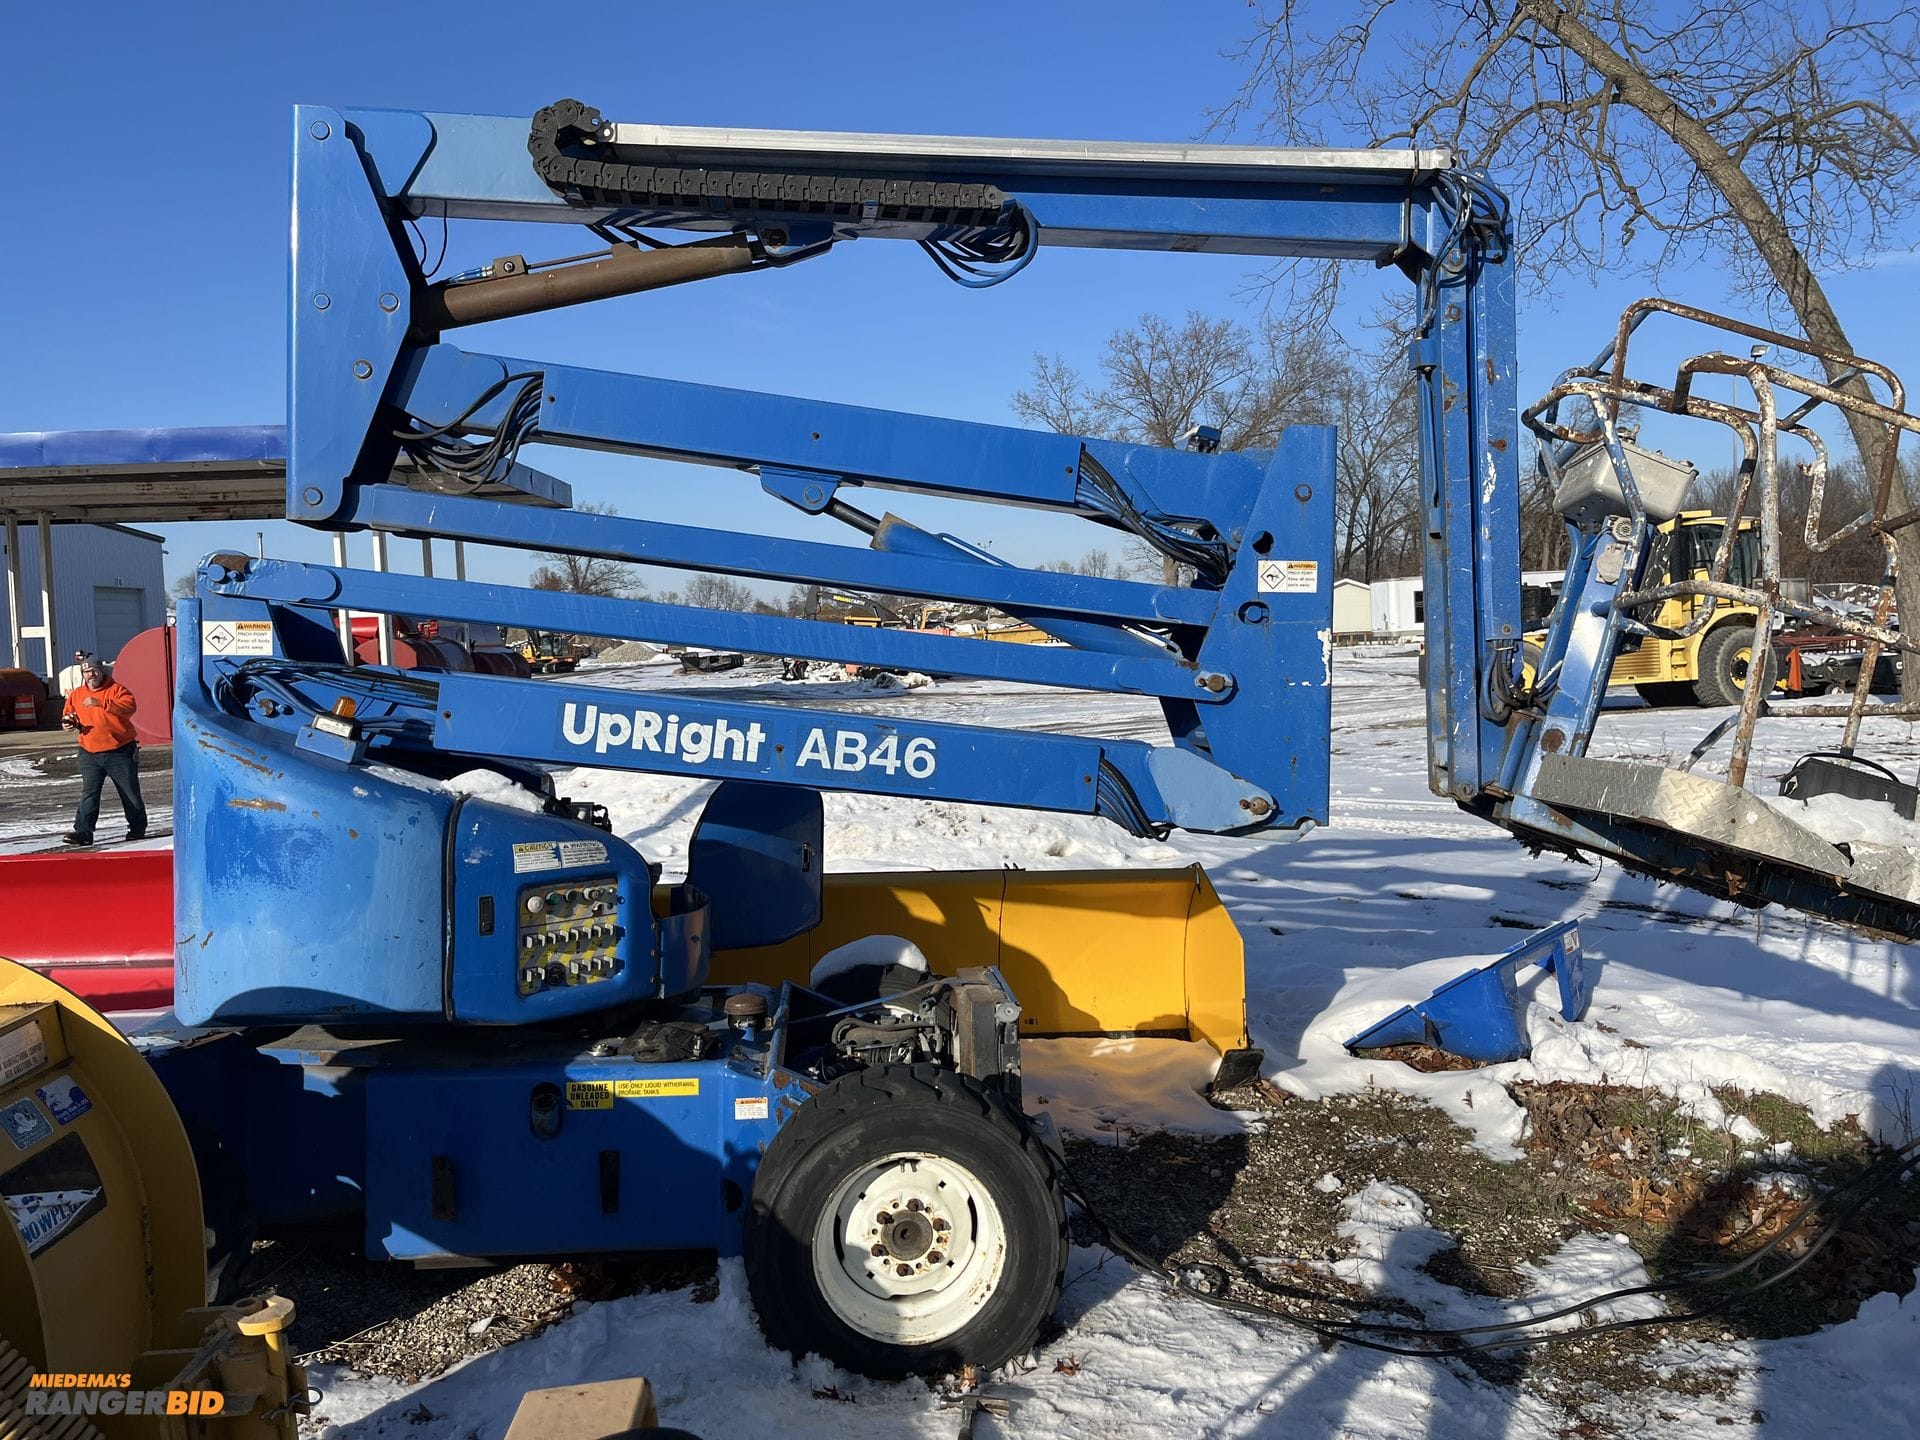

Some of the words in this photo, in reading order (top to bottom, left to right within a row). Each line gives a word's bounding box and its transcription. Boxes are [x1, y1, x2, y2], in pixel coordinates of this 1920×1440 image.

[562, 702, 767, 764] UpRight
[795, 728, 937, 780] AB46
[571, 1083, 609, 1092] GASOLINE
[570, 1091, 610, 1100] UNLEADED
[580, 1099, 600, 1108] ONLY
